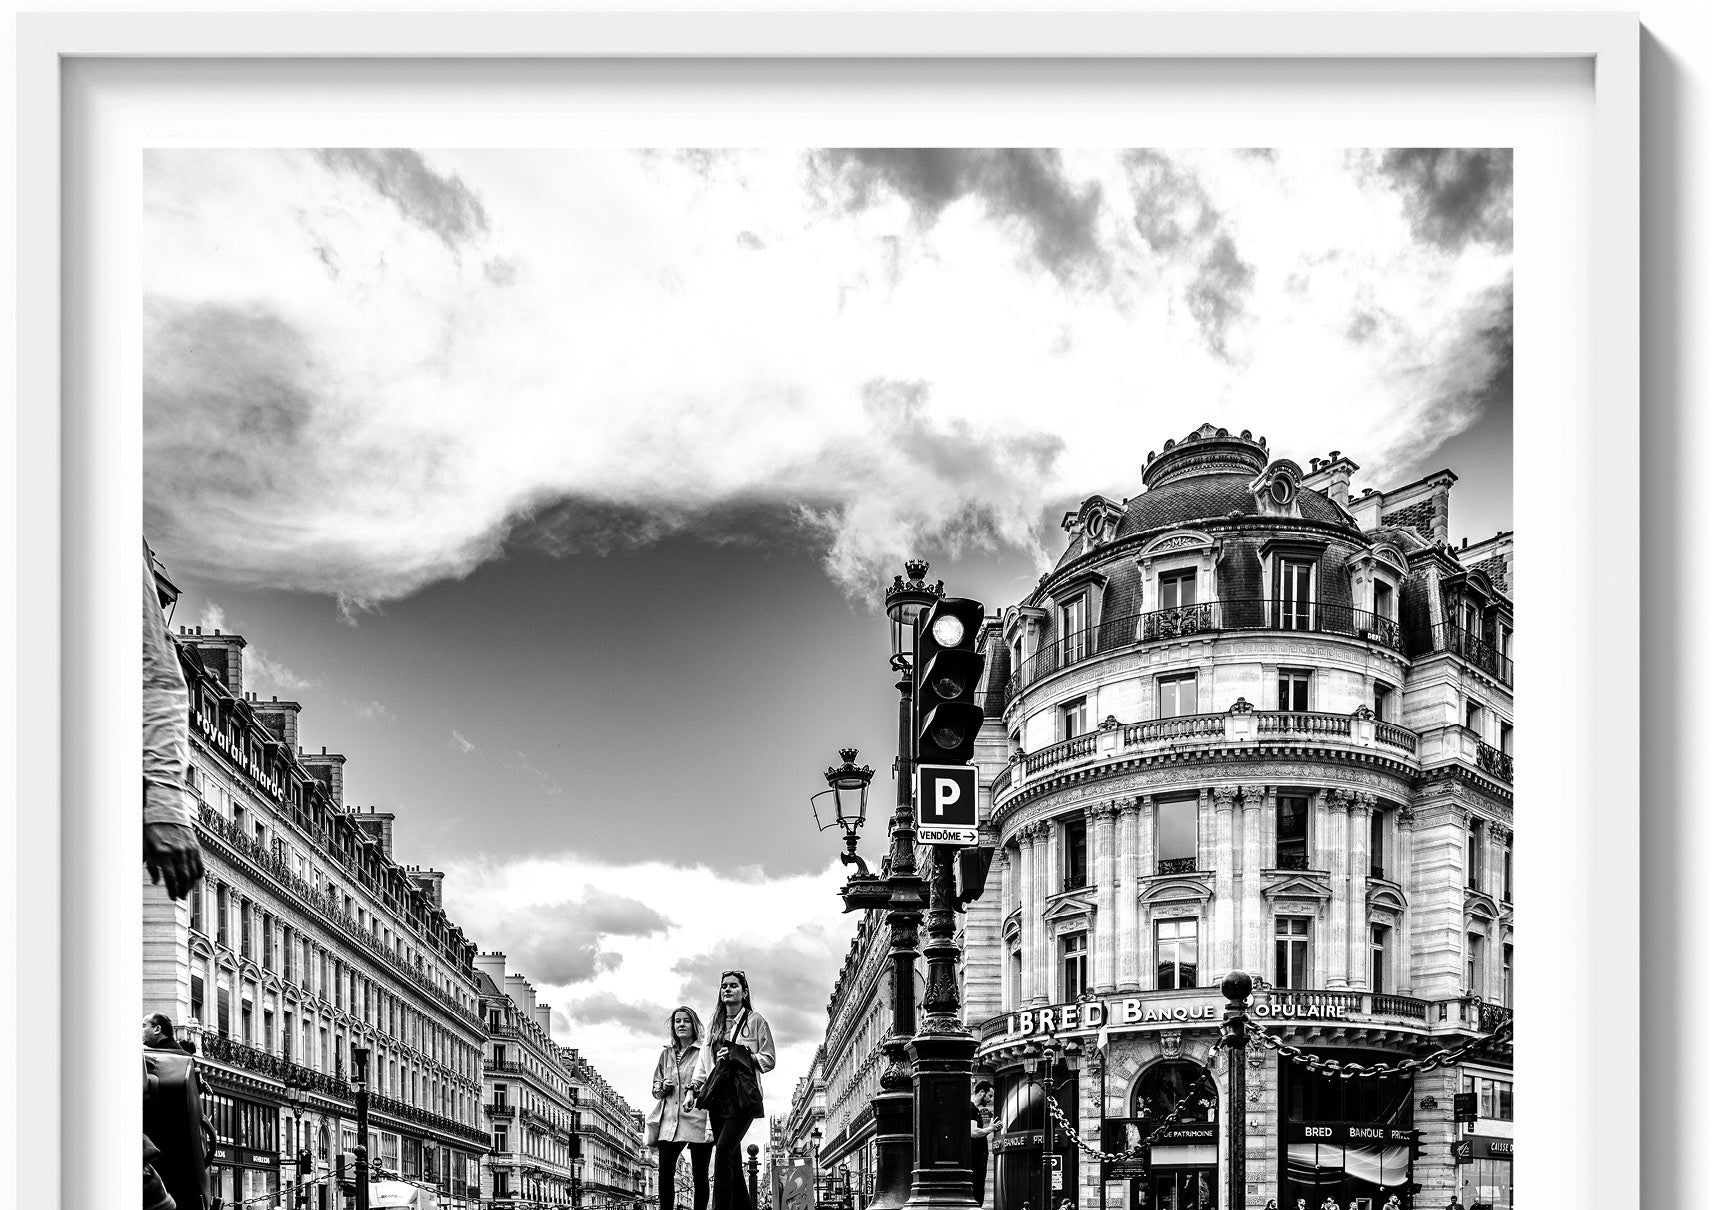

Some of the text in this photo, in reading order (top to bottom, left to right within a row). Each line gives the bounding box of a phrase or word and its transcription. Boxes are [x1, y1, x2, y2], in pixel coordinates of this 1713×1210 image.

[196, 711, 284, 802] royal air maroc
[935, 777, 961, 816] P
[920, 830, 961, 841] VENDÔME
[1020, 1000, 1104, 1037] BRED
[1122, 998, 1214, 1024] BANQUE
[1173, 1130, 1213, 1138] PATRIMOINE
[1305, 1127, 1333, 1137] BRED
[1349, 1127, 1384, 1138] BANQUE
[1491, 1142, 1509, 1152] CAISSE
